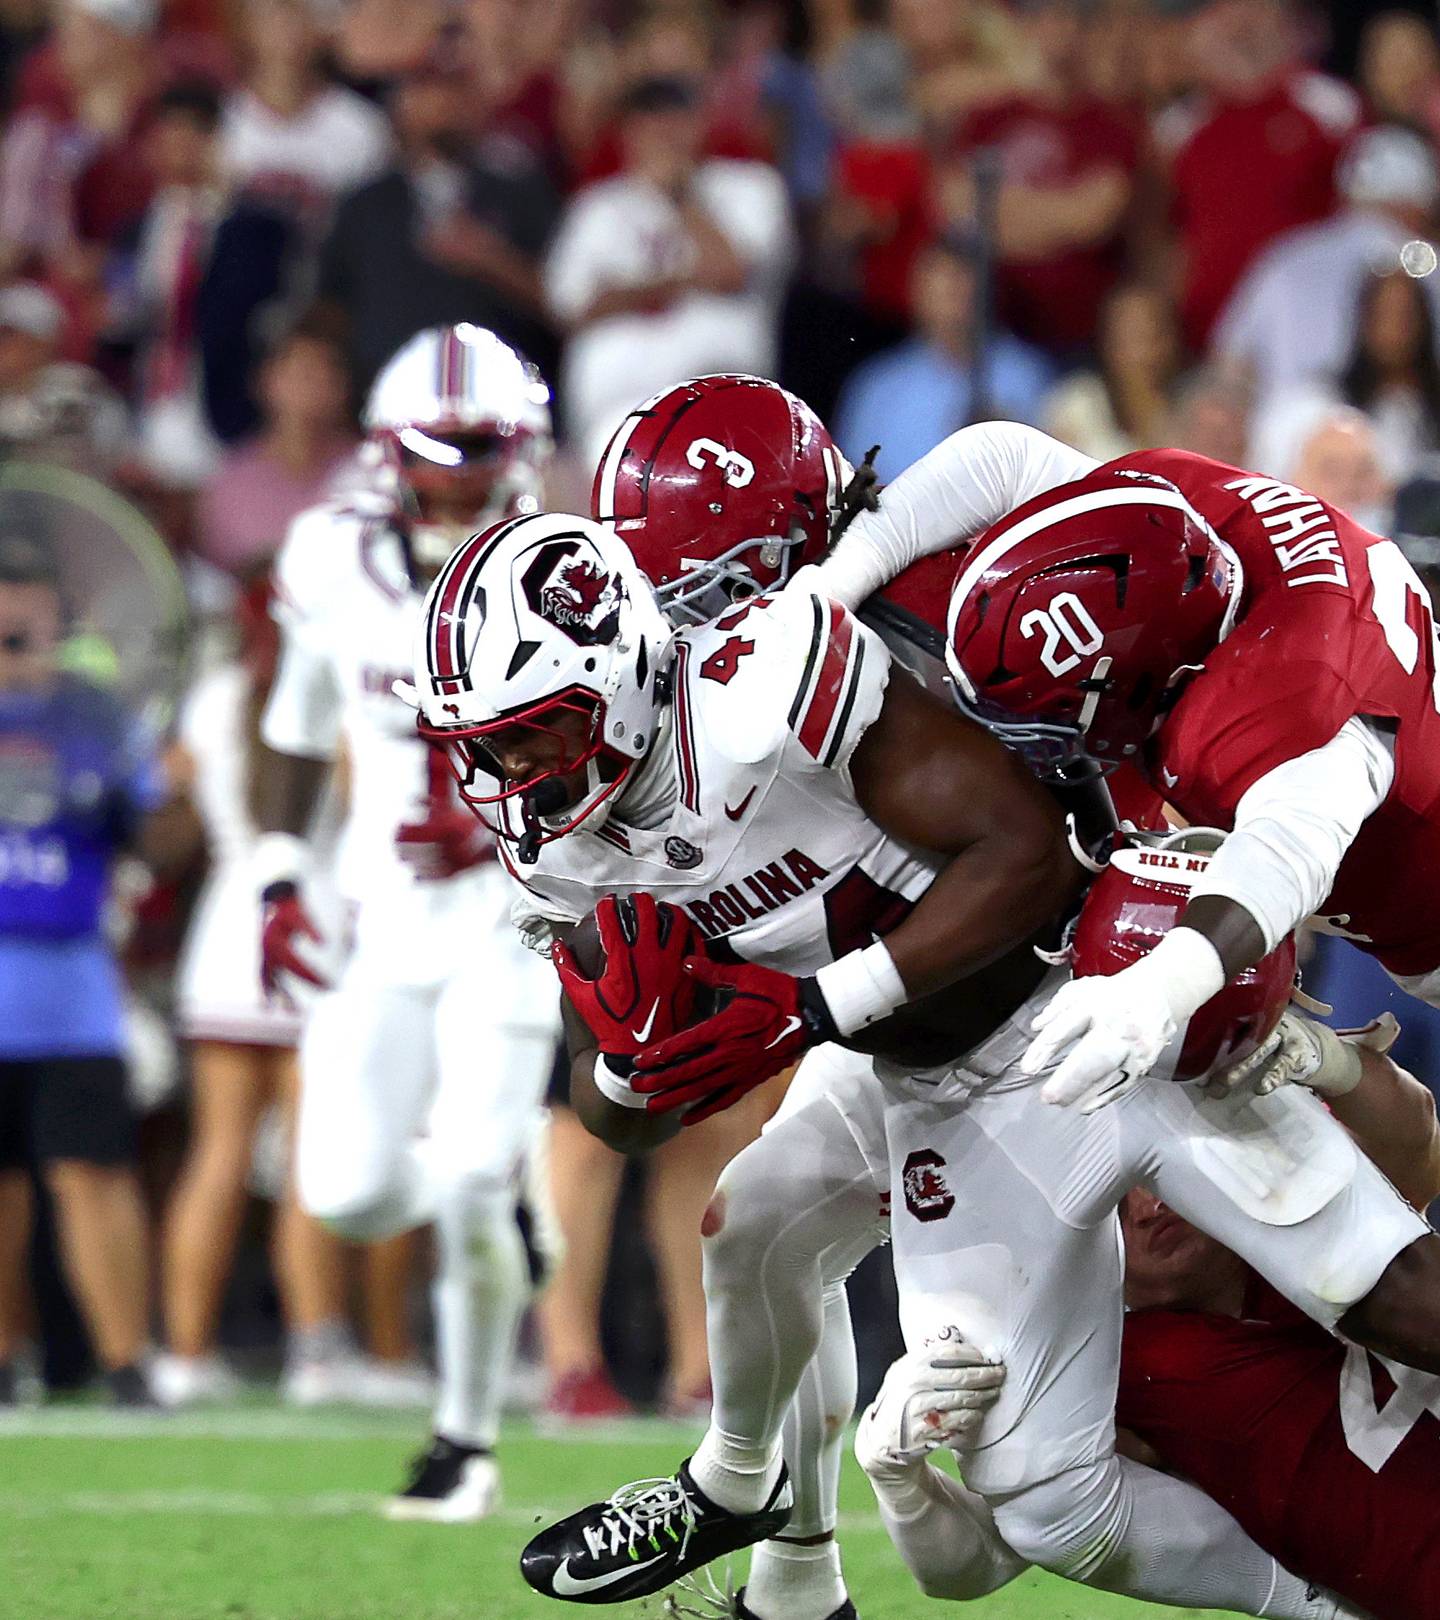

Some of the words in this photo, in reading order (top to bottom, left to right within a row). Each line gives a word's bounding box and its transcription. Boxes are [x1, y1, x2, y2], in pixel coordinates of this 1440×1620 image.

[685, 437, 755, 489] 3
[1019, 591, 1105, 679] 20
[687, 848, 831, 940] ROLINA
